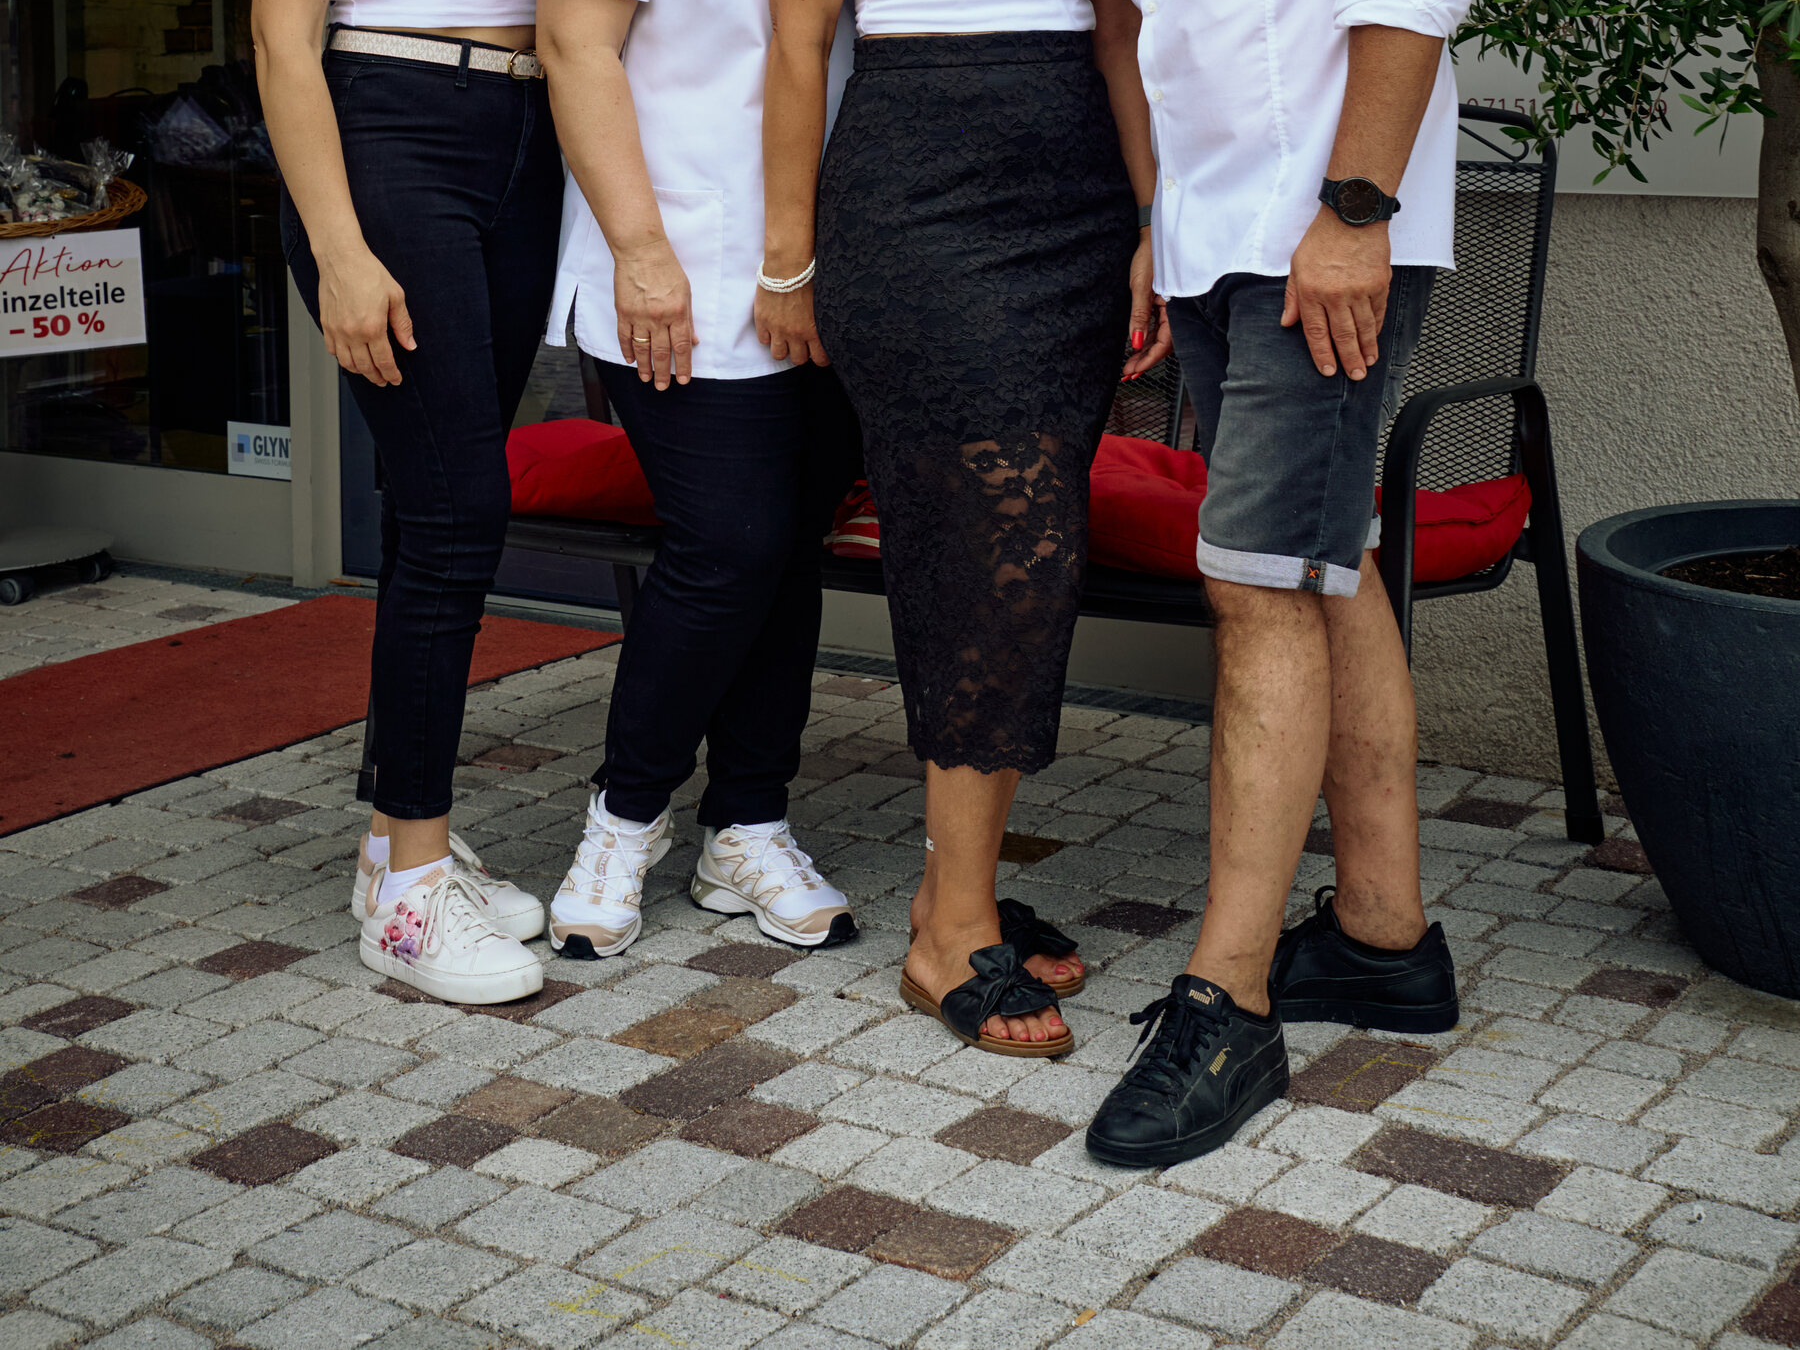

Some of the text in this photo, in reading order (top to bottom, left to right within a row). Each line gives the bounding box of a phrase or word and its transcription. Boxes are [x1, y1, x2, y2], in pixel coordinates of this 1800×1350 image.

[0, 246, 123, 286] Aktion
[0, 281, 125, 314] inzelteile
[253, 435, 291, 459] GLYN
[1188, 988, 1211, 1005] PUMA
[1208, 1050, 1227, 1076] PUMA
